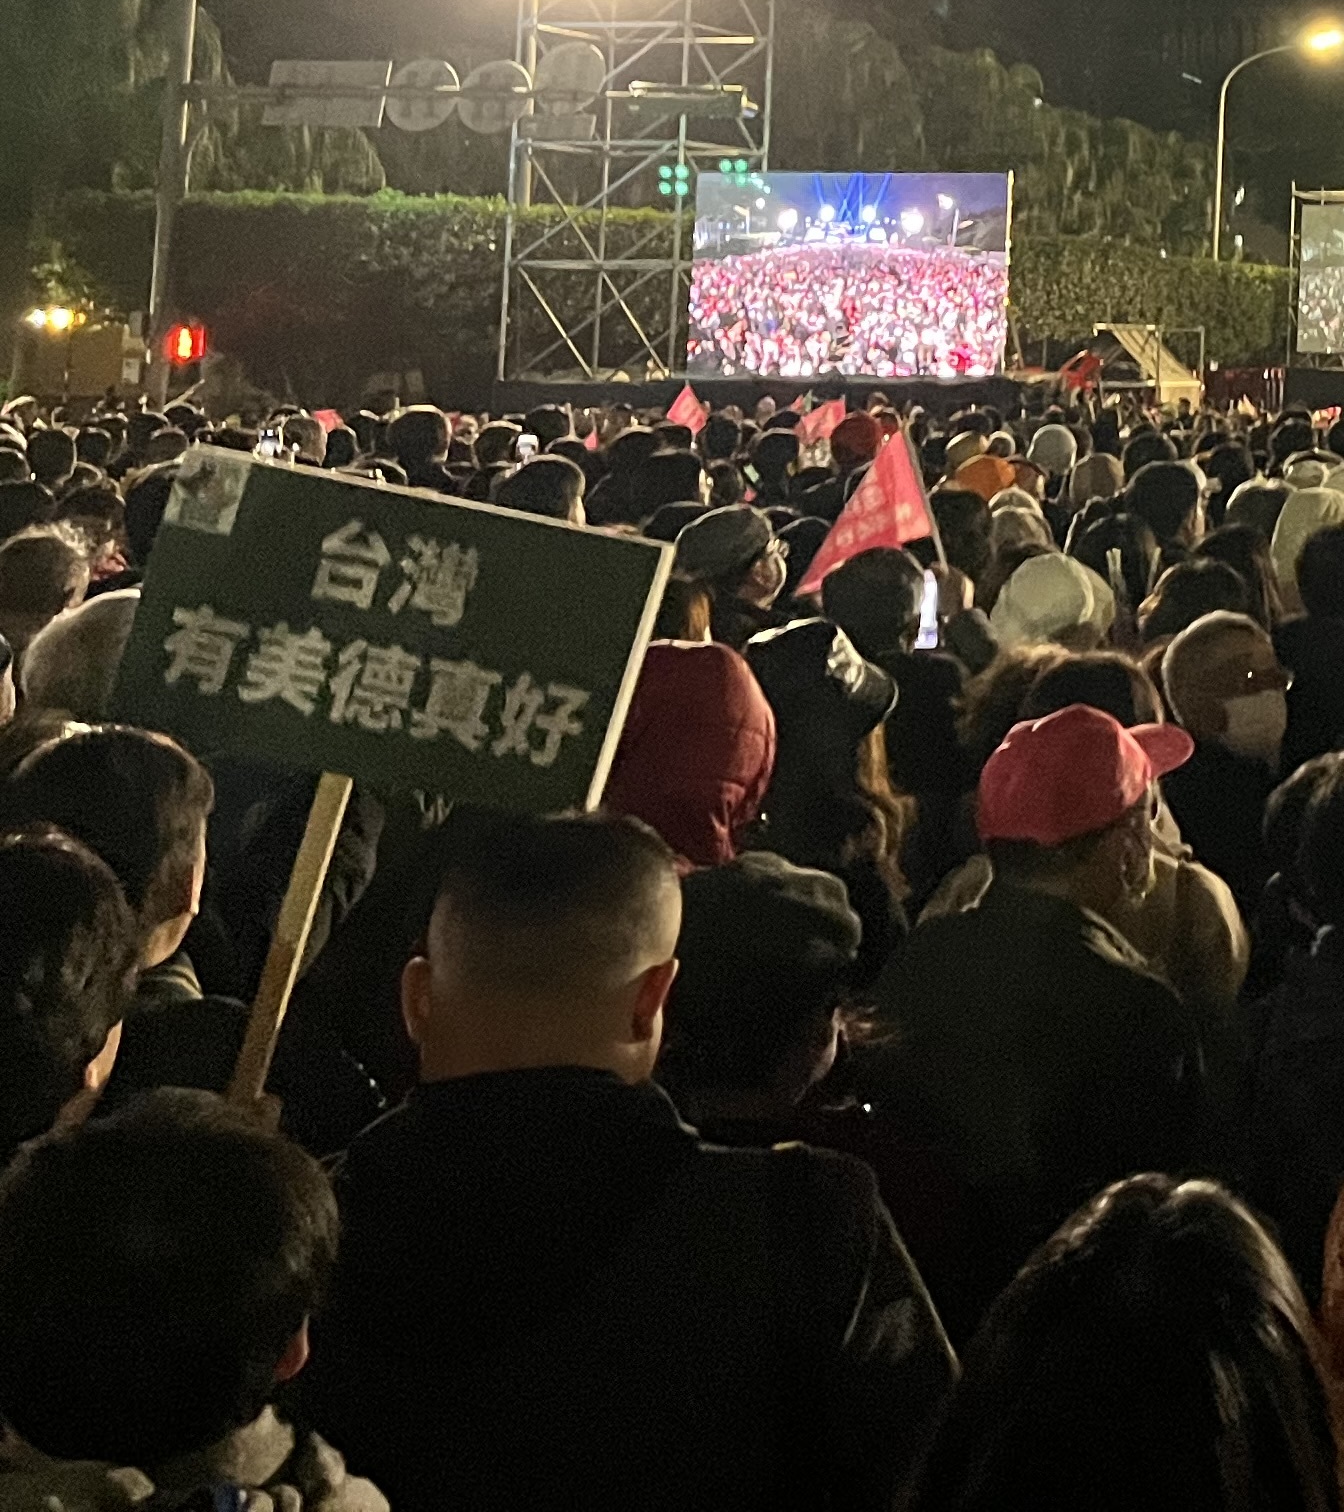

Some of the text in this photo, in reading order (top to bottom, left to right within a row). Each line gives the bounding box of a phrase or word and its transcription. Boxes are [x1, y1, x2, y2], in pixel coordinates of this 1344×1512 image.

[309, 517, 479, 627] 台灣
[163, 604, 591, 767] 有美德真好
